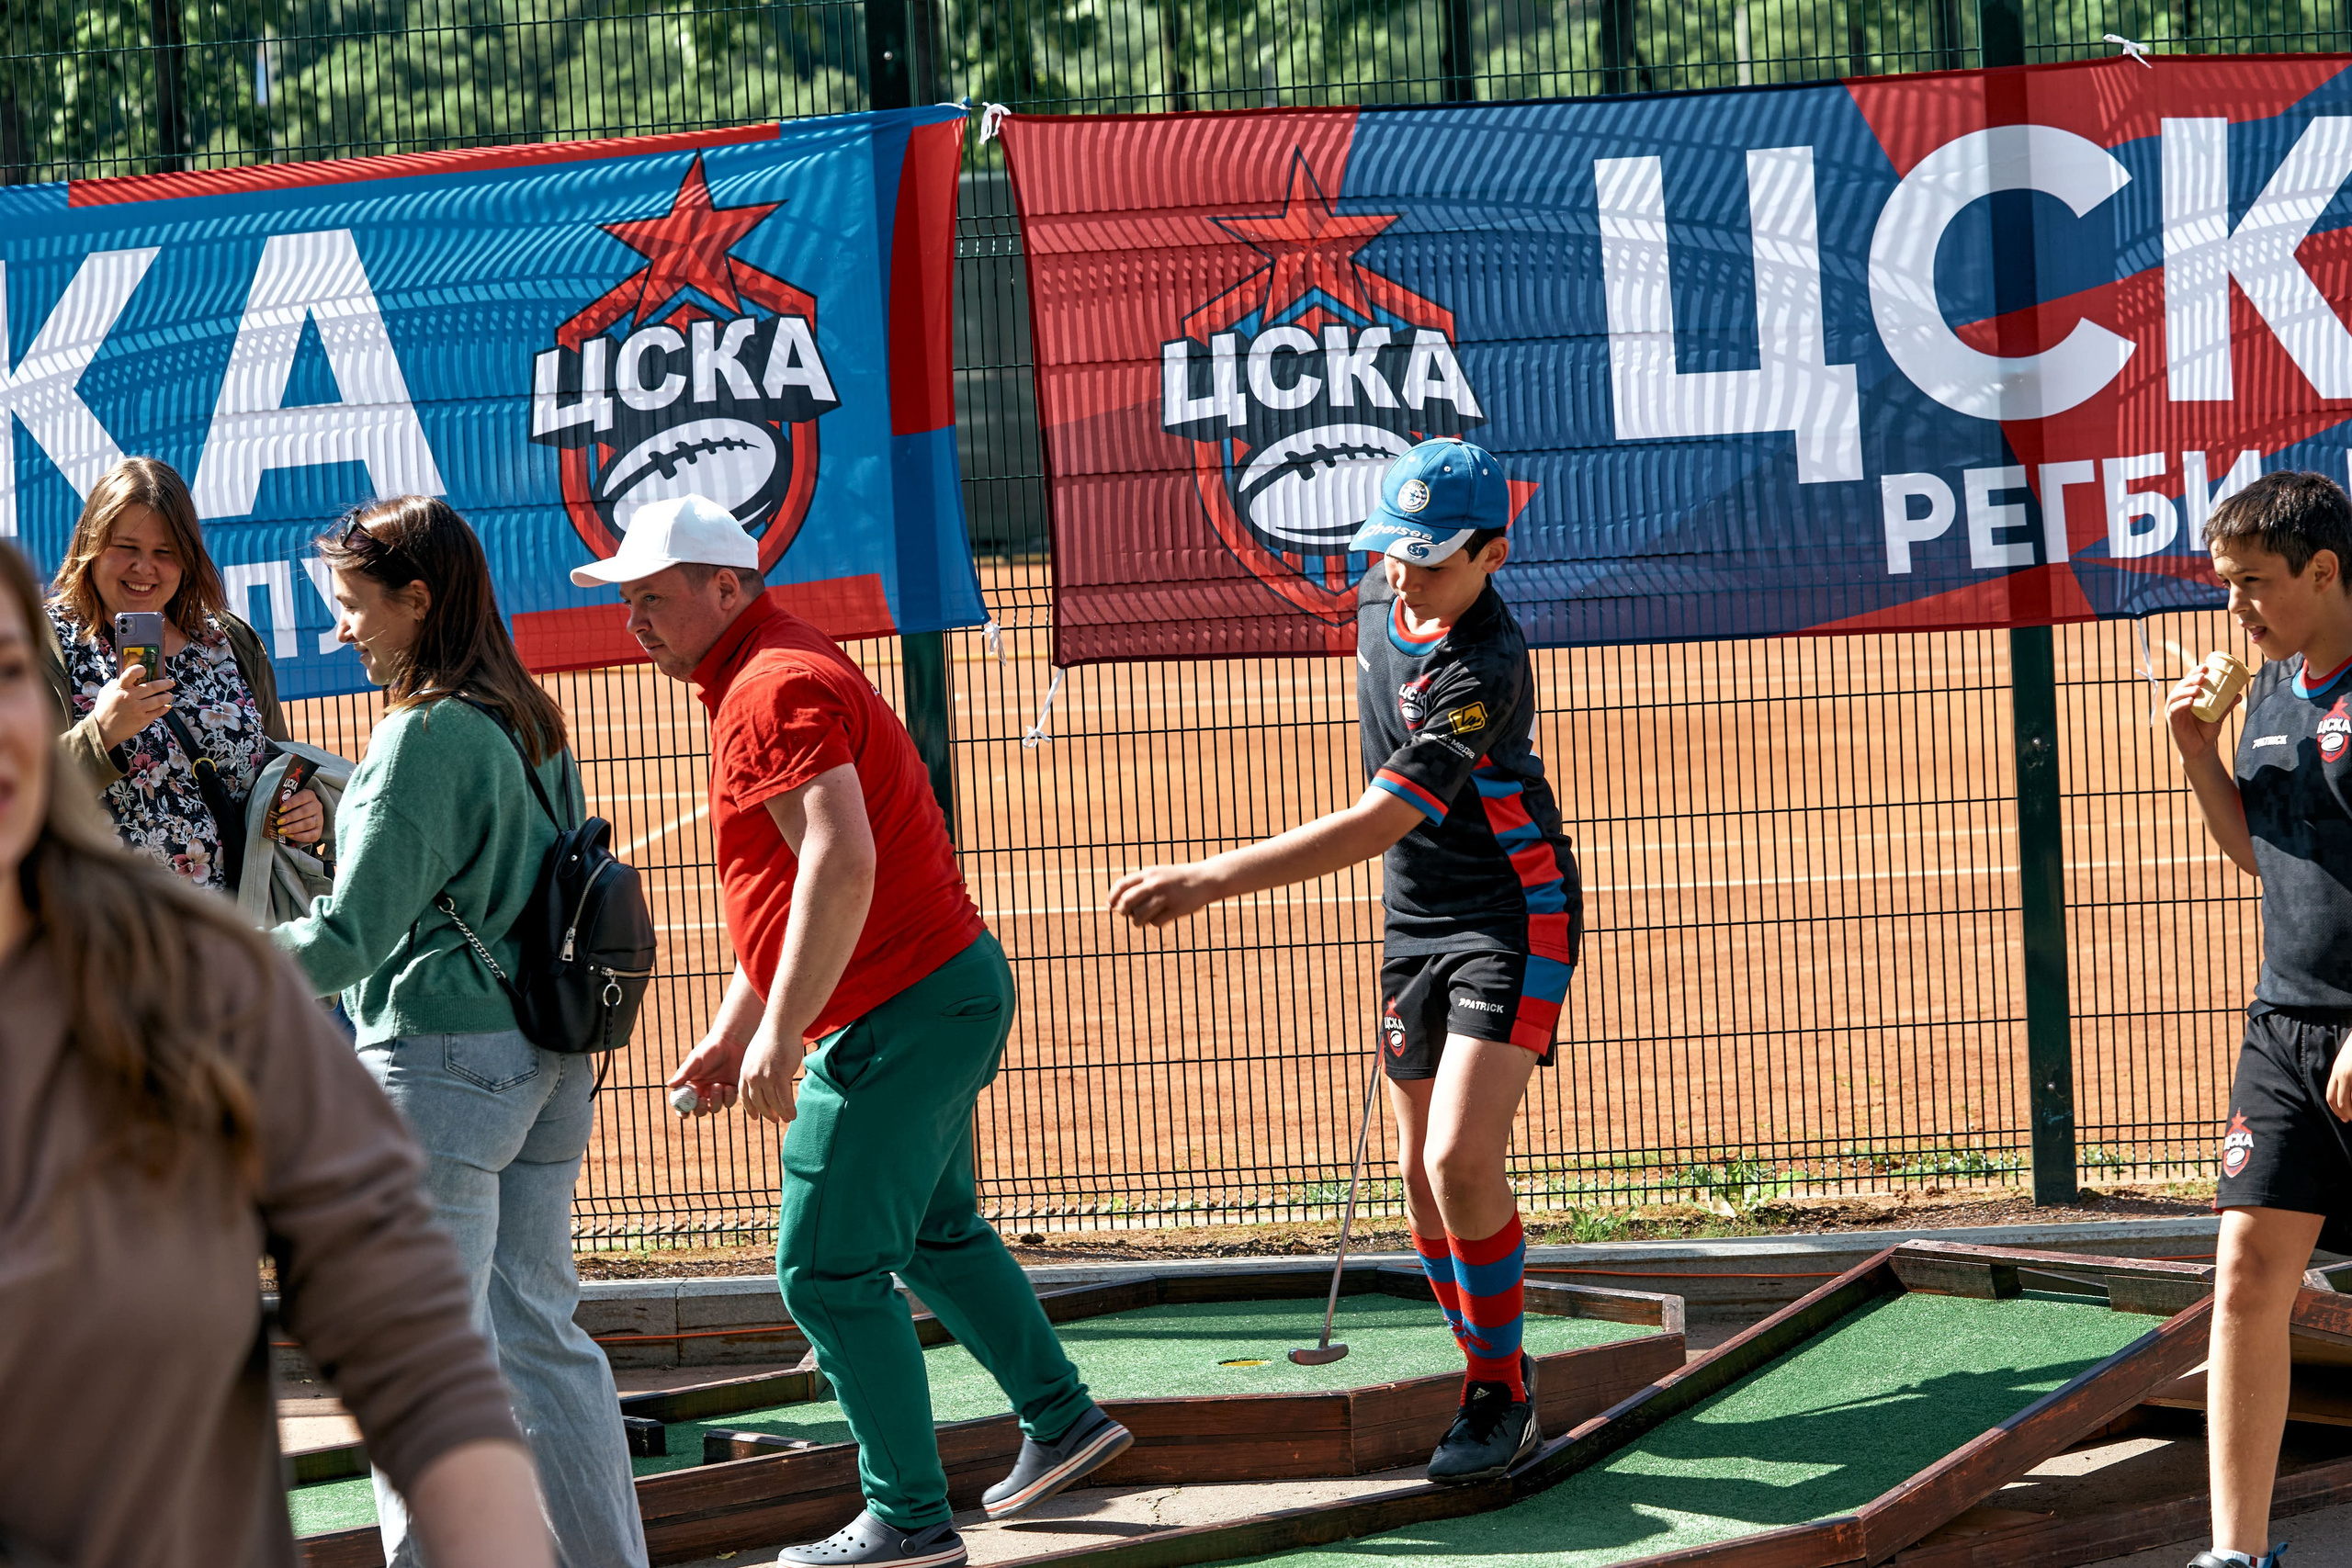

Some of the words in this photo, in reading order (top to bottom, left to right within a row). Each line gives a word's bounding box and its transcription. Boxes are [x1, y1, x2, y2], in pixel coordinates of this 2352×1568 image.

[532, 316, 838, 437] ЦСКА
[1163, 324, 1486, 427] ЦСКА
[1881, 448, 2263, 575] РЕГБИ
[1398, 683, 1426, 706] ЦСК
[2316, 717, 2352, 734] ЦСКА
[1384, 1016, 1406, 1032] ЦСКА
